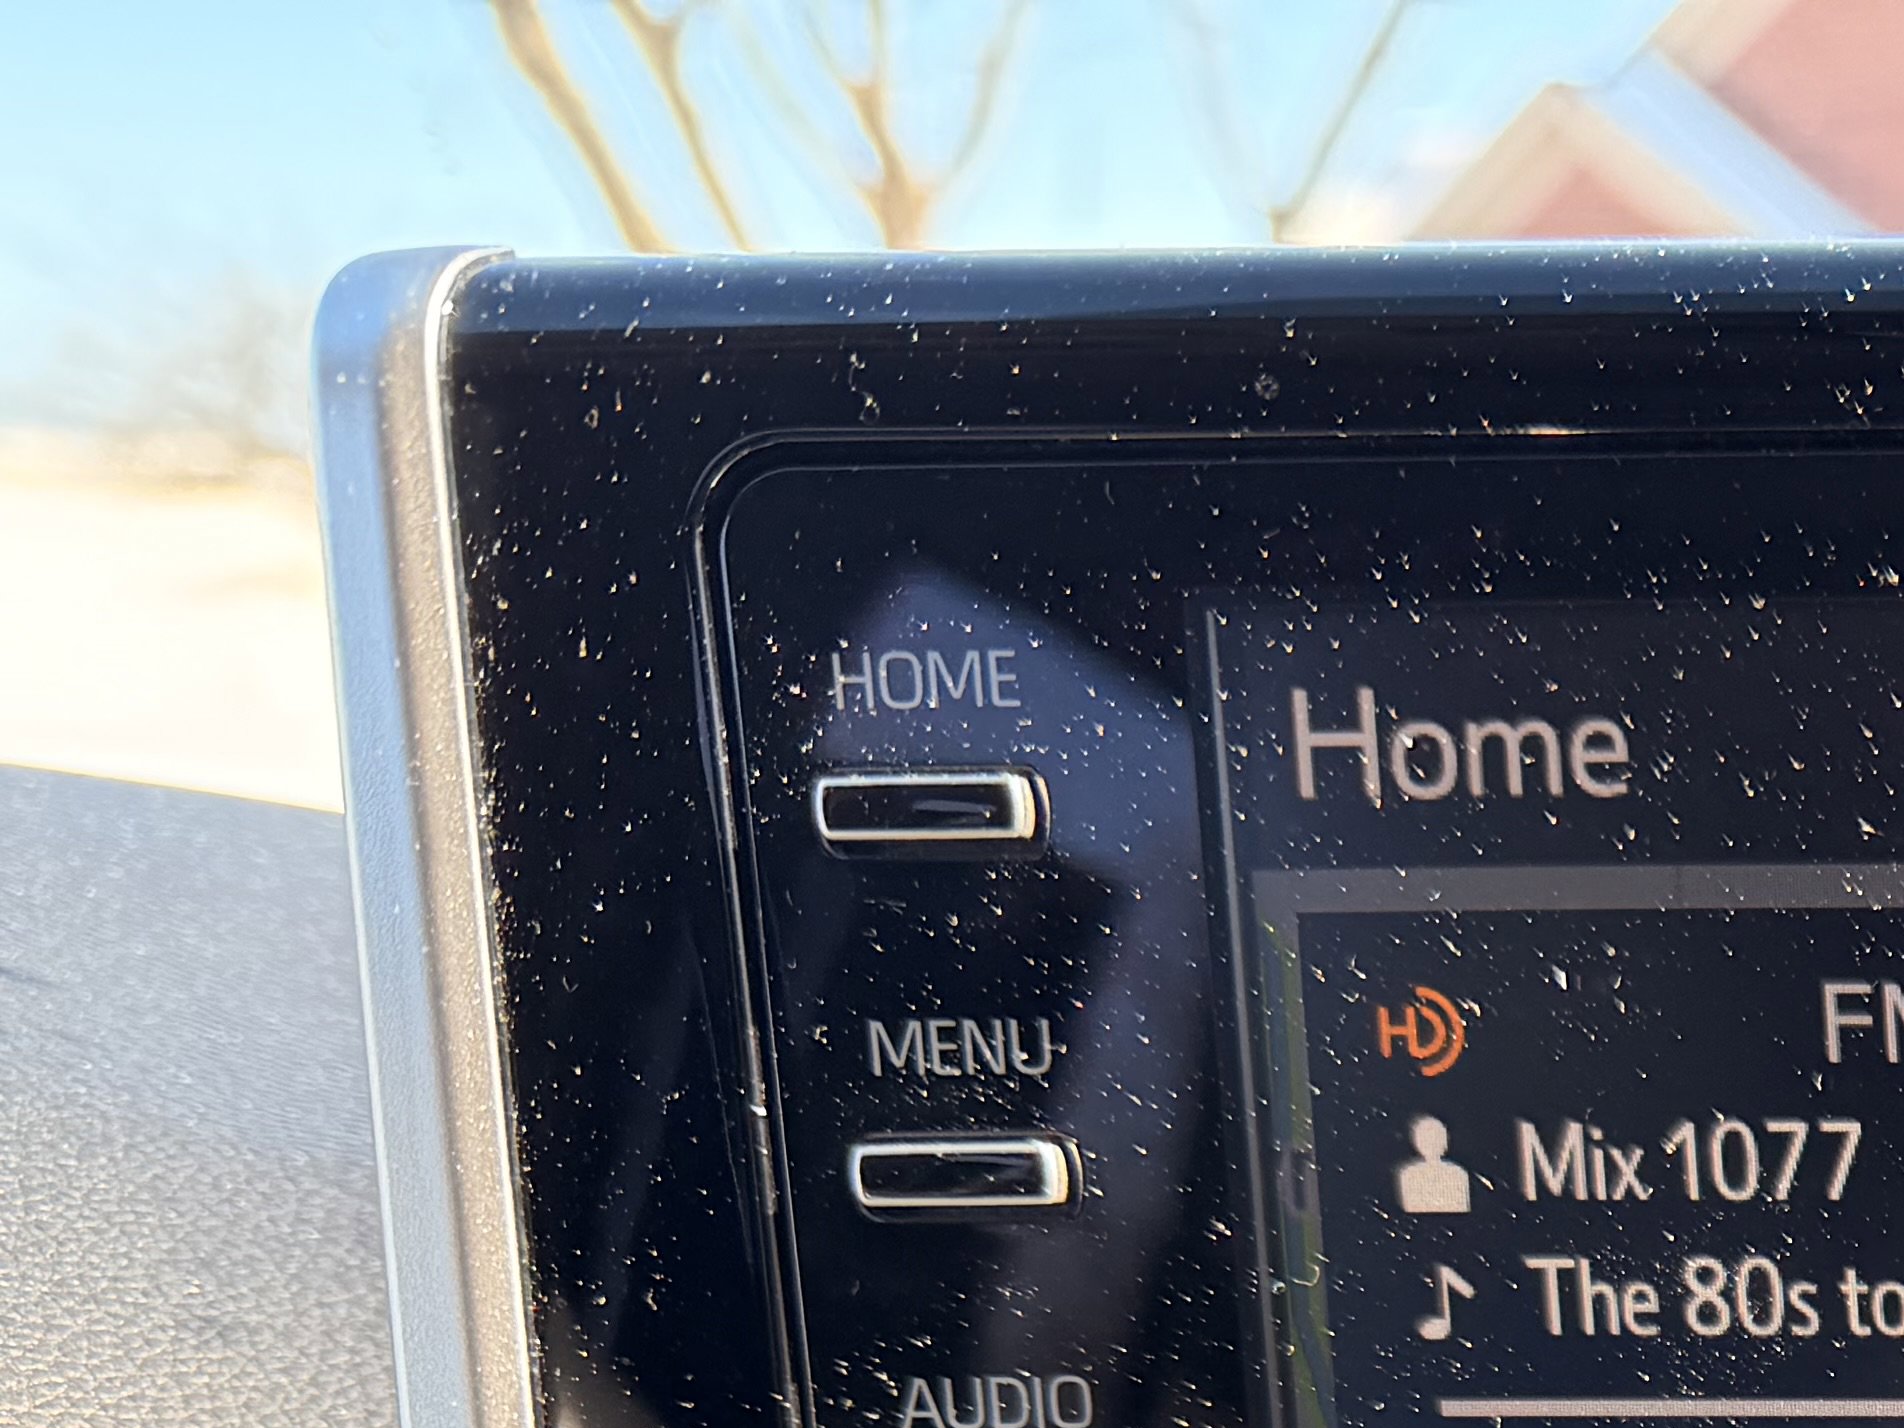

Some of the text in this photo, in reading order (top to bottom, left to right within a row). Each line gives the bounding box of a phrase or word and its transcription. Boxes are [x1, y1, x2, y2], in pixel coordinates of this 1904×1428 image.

[831, 649, 1022, 711] HOME
[1288, 686, 1631, 801] Home
[867, 1018, 1054, 1077] MENU
[1515, 1117, 1863, 1201] Mix 1077
[1521, 1254, 1660, 1338] The
[1681, 1254, 1820, 1338] 80s
